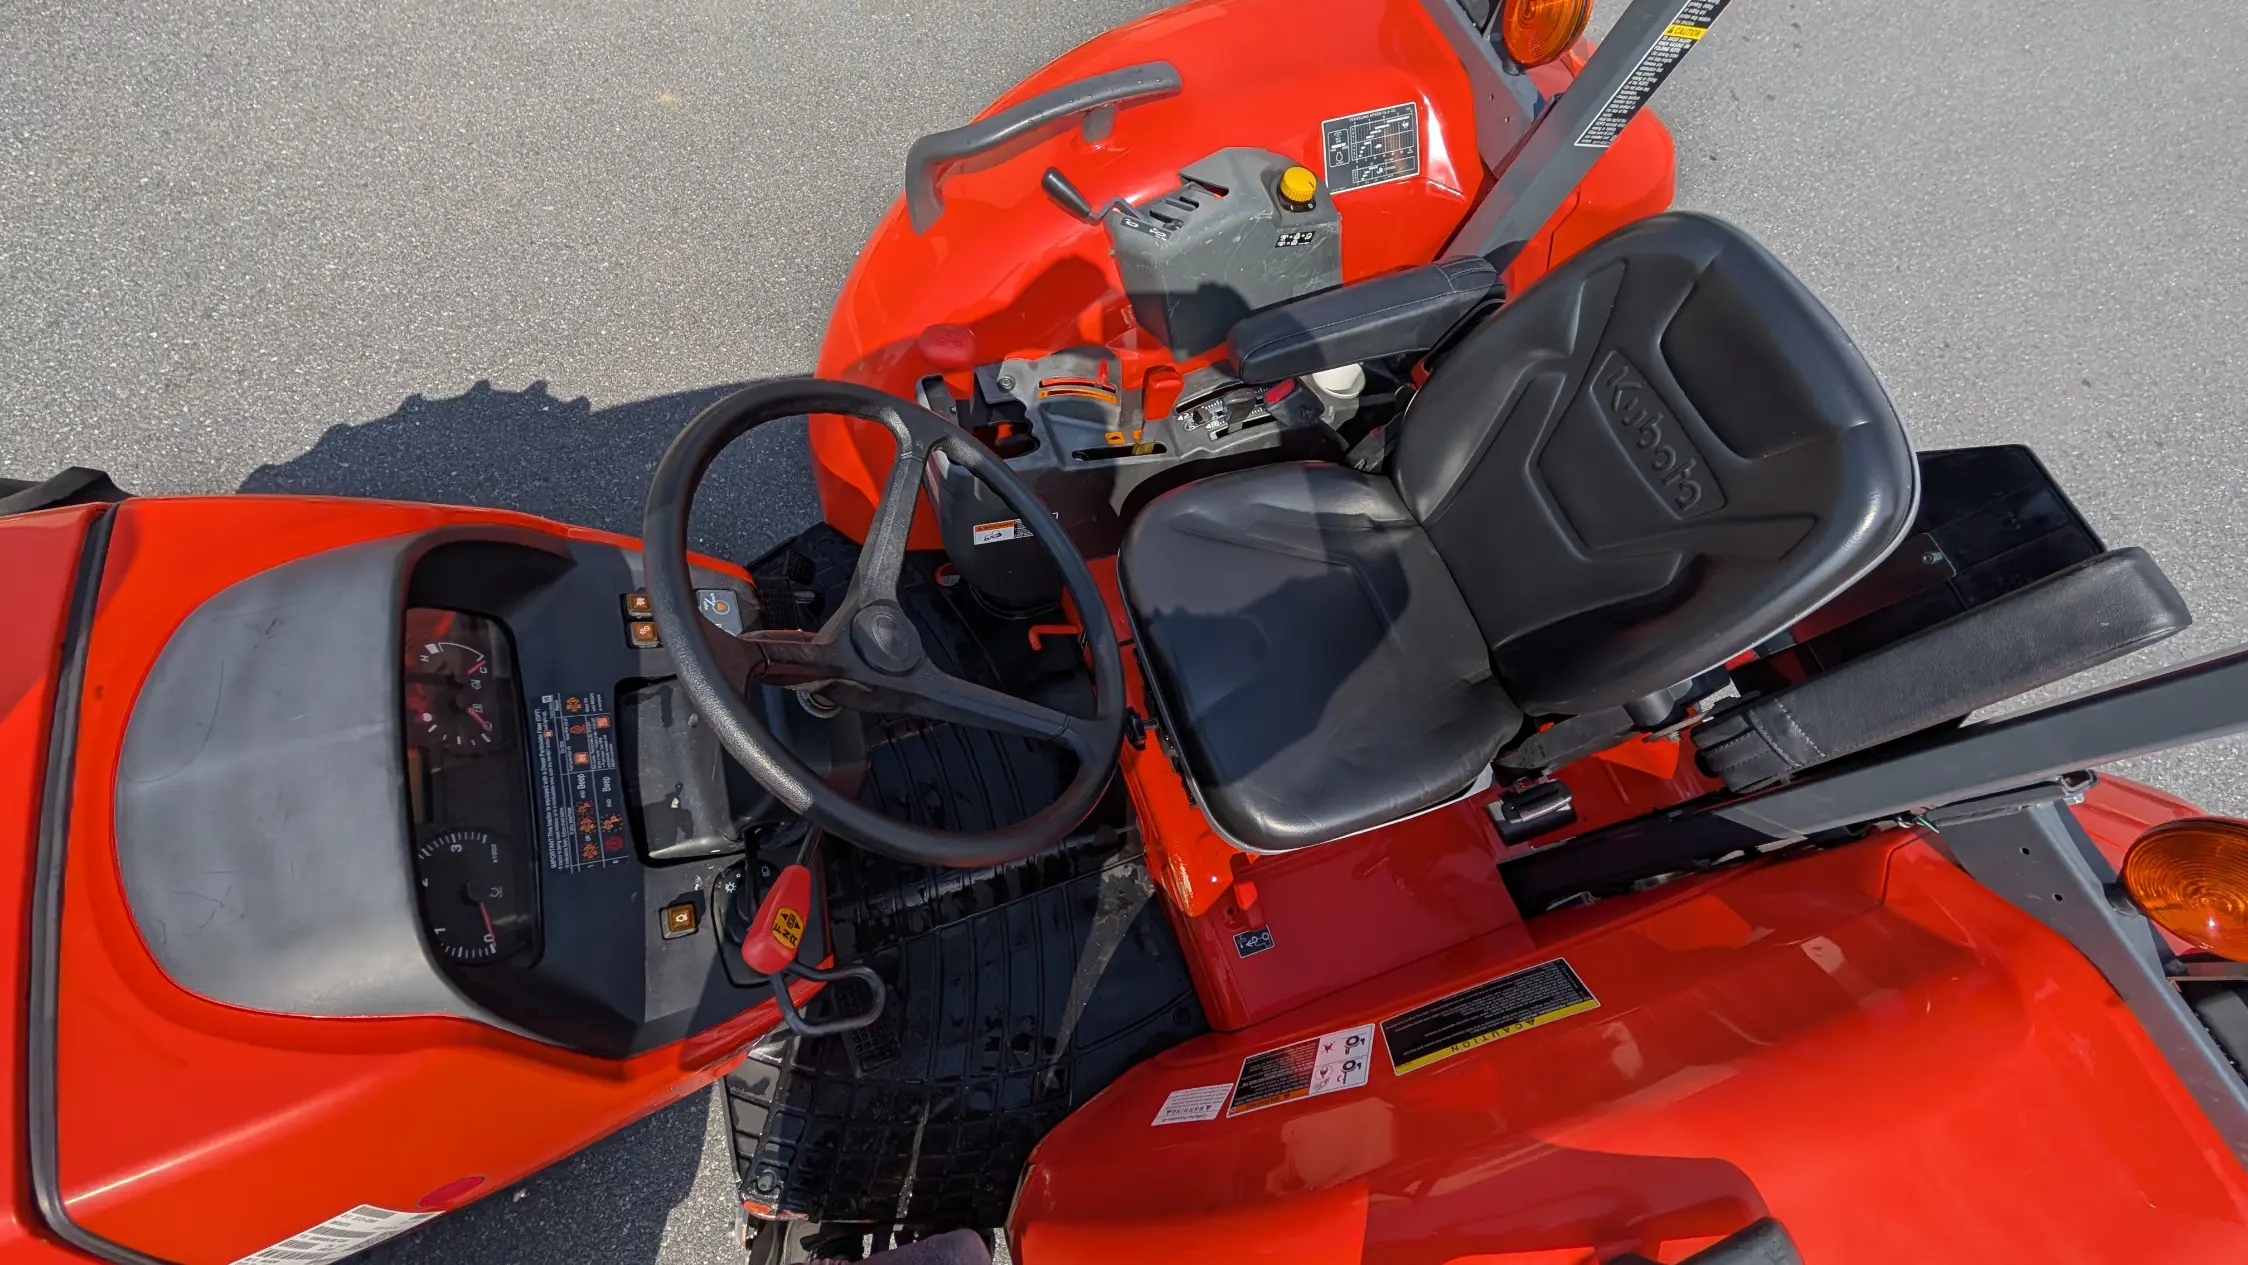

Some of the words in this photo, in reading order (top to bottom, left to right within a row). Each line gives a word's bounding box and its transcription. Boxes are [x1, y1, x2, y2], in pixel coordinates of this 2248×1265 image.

[1674, 28, 1703, 37] CAUTION
[1606, 365, 1702, 511] Kubota
[539, 756, 547, 771] Diesel
[575, 772, 587, 790] Beep
[600, 775, 612, 792] Beep
[451, 844, 463, 853] 3
[434, 927, 446, 935] 1
[1450, 1022, 1523, 1052] CAUTION
[1172, 1106, 1205, 1115] WARNING
